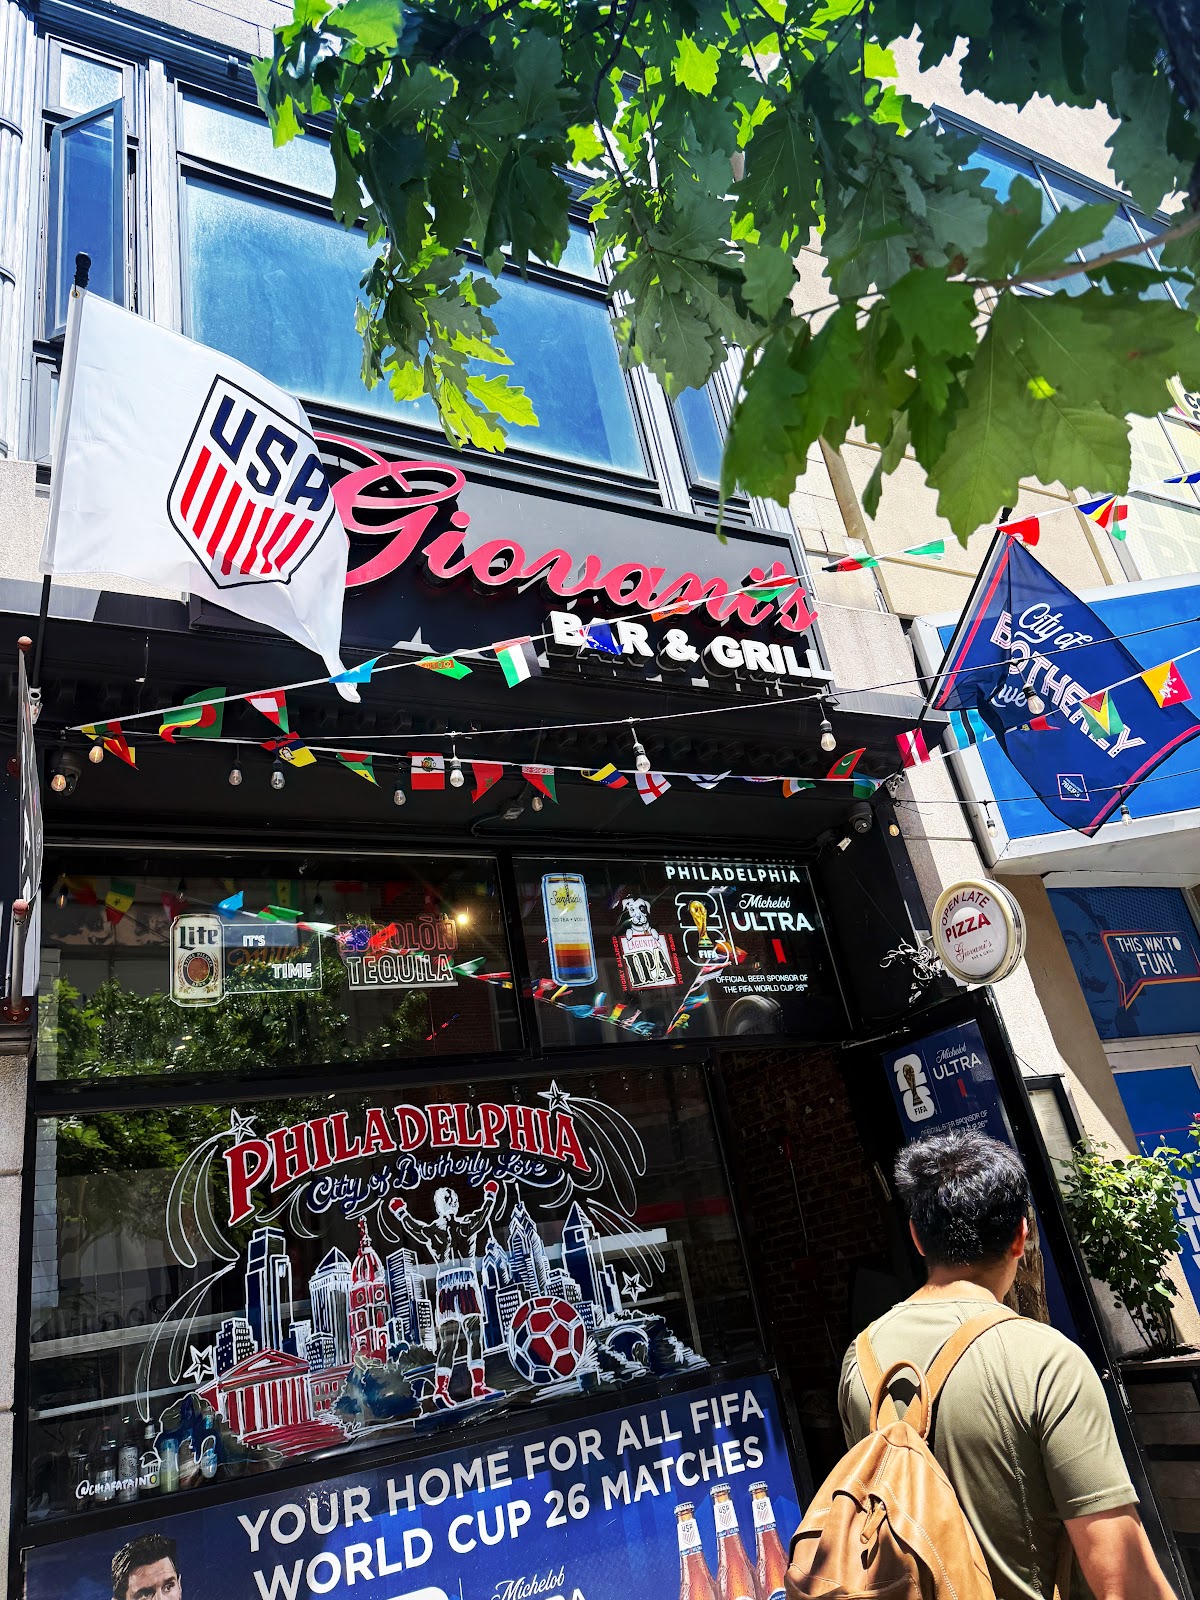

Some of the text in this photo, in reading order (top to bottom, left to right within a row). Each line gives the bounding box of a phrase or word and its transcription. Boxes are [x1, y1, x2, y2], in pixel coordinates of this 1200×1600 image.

[210, 394, 330, 512] USA
[313, 431, 819, 633] Giovani's
[1014, 602, 1094, 650] City of
[662, 629, 700, 662] &
[706, 636, 832, 681] GRILL
[665, 866, 800, 883] PHILADELPHIA
[739, 893, 791, 909] Michelob
[942, 891, 990, 926] OPEN LATE
[731, 912, 815, 931] ULTRA
[945, 913, 991, 942] PIZZA
[178, 926, 219, 950] Lite
[242, 935, 266, 947] IT'S
[627, 939, 662, 950] LAGUNITAS
[1115, 937, 1182, 952] THIS WAY TO
[698, 950, 717, 959] FIFA
[1136, 952, 1178, 975] FUN!
[271, 963, 312, 979] TIME
[347, 954, 454, 984] TEQUILA
[623, 948, 676, 987] IPA
[766, 974, 799, 982] SPONSOR
[799, 974, 809, 982] OF
[723, 986, 738, 994] THE
[738, 985, 754, 993] FIFA
[754, 985, 779, 993] WORLD
[780, 984, 794, 992] CUP
[936, 1042, 967, 1063] Michelob
[932, 1052, 983, 1080] ULTRA
[914, 1105, 928, 1116] FIFA
[980, 1109, 988, 1118] OF
[223, 1103, 591, 1227] PHILADELPHIA
[307, 1151, 555, 1215] City of Brotherly Love
[237, 1389, 765, 1553] YOUR HOME FOR ALL FIFA
[253, 1435, 764, 1600] WORLD CUP 26 MATCHES
[491, 1565, 565, 1600] Michelob
